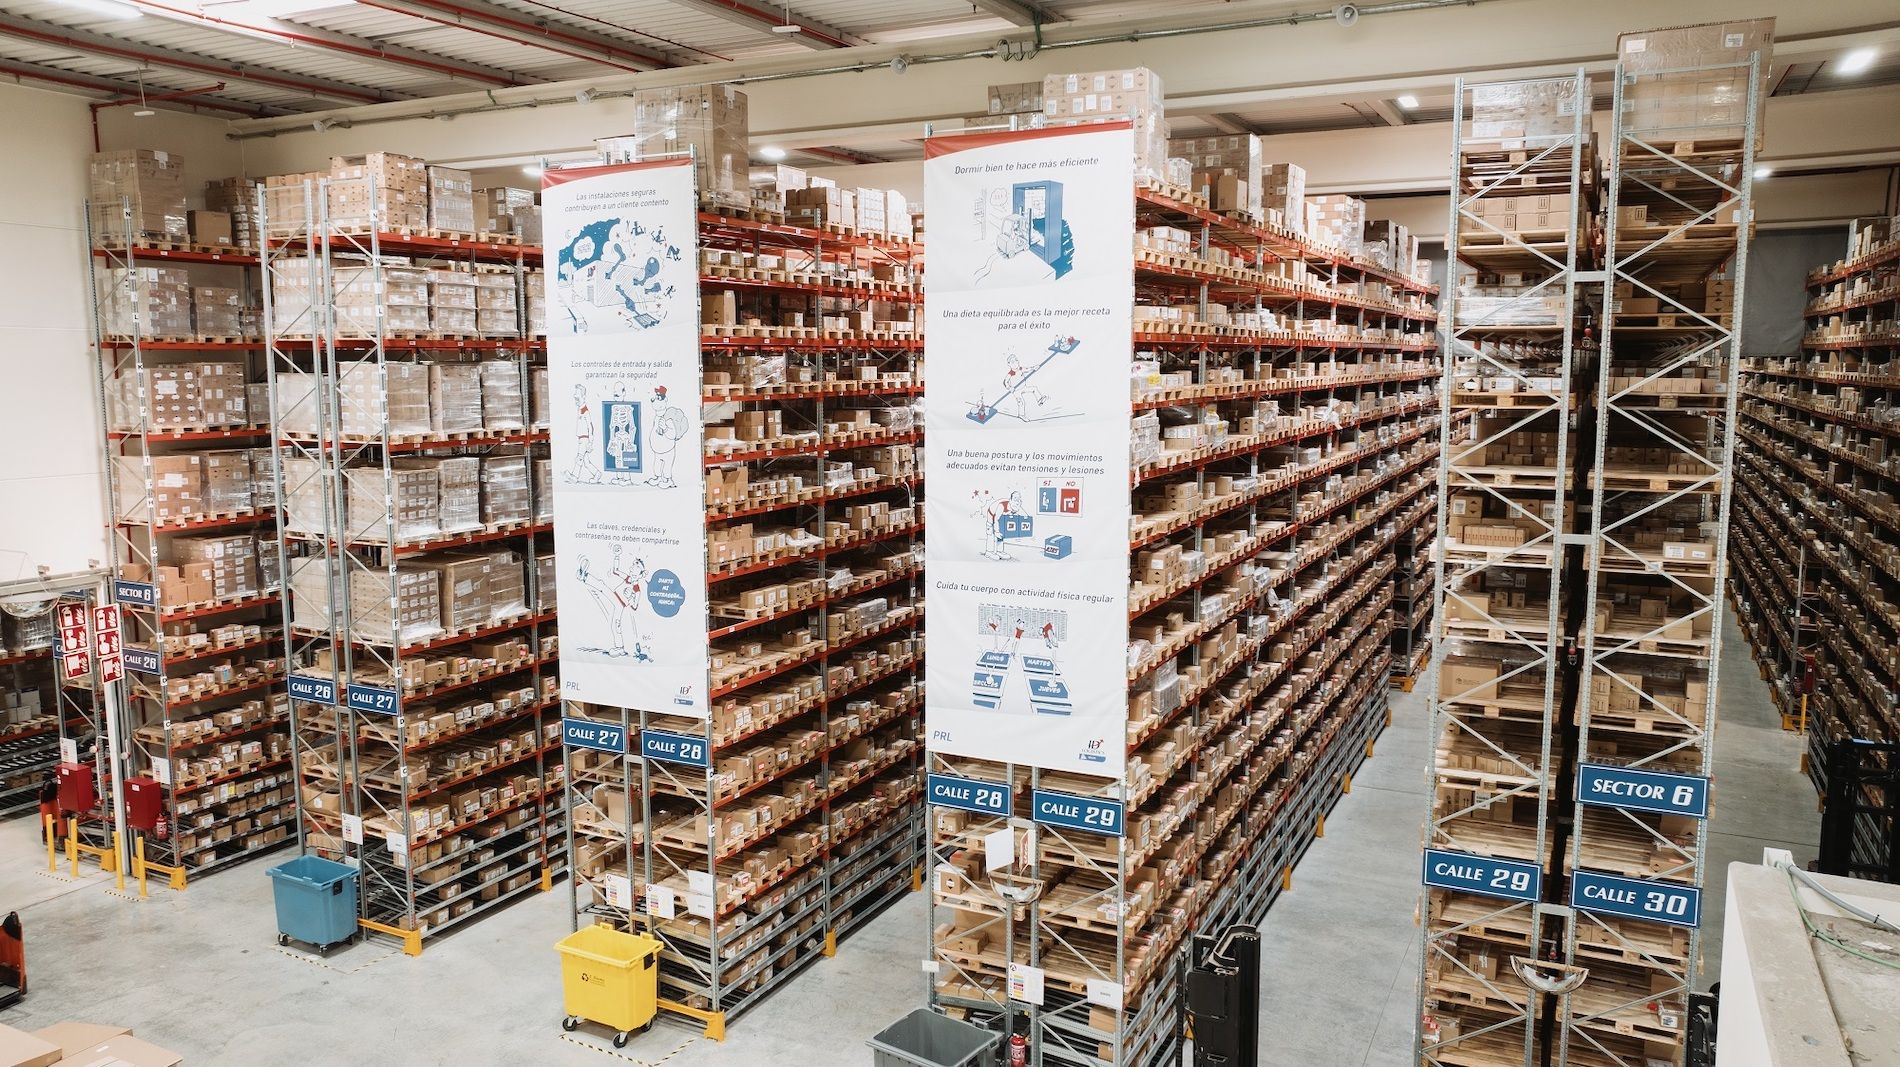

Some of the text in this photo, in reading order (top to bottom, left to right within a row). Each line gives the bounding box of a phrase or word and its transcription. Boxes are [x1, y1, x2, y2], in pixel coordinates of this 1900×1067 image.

[954, 165, 984, 175] Dormir
[985, 163, 1003, 173] bien
[1005, 162, 1014, 171] te
[1016, 160, 1038, 170] hace
[1059, 156, 1100, 168] eficiente
[630, 188, 657, 199] seguras
[616, 200, 640, 208] cliente
[640, 198, 670, 208] contento
[942, 306, 1111, 320] Una dieta equilibrada es la mejor receta
[997, 320, 1052, 332] para el éxito
[622, 360, 646, 368] entrada
[653, 360, 673, 368] salida
[946, 448, 1104, 463] Una buena postura y los movimientos
[946, 462, 1105, 476] adecuados evitan tensiones y lesiones
[642, 536, 680, 546] compartirse
[118, 587, 152, 601] SECTOR 6
[936, 580, 959, 591] Cuida
[960, 583, 970, 592] tu
[970, 584, 999, 596] cuerpo
[1000, 587, 1016, 596] con
[1017, 588, 1056, 599] actividad
[1082, 594, 1115, 604] regular
[124, 654, 156, 670] CALLE 26
[1026, 658, 1052, 668] MARTES
[292, 682, 332, 700] CALLE 26
[566, 680, 582, 692] PRL
[351, 692, 394, 710] CALLE 27
[568, 726, 620, 747] CALLE 27
[933, 730, 953, 742] PRL
[647, 740, 702, 760] CALLE 28
[934, 784, 1002, 809] CALLE 28
[1591, 778, 1694, 808] SECTOR 6
[1041, 802, 1116, 827] CALLE 29
[1434, 862, 1531, 892] CALLE 29
[1582, 884, 1689, 917] CALLE 30
